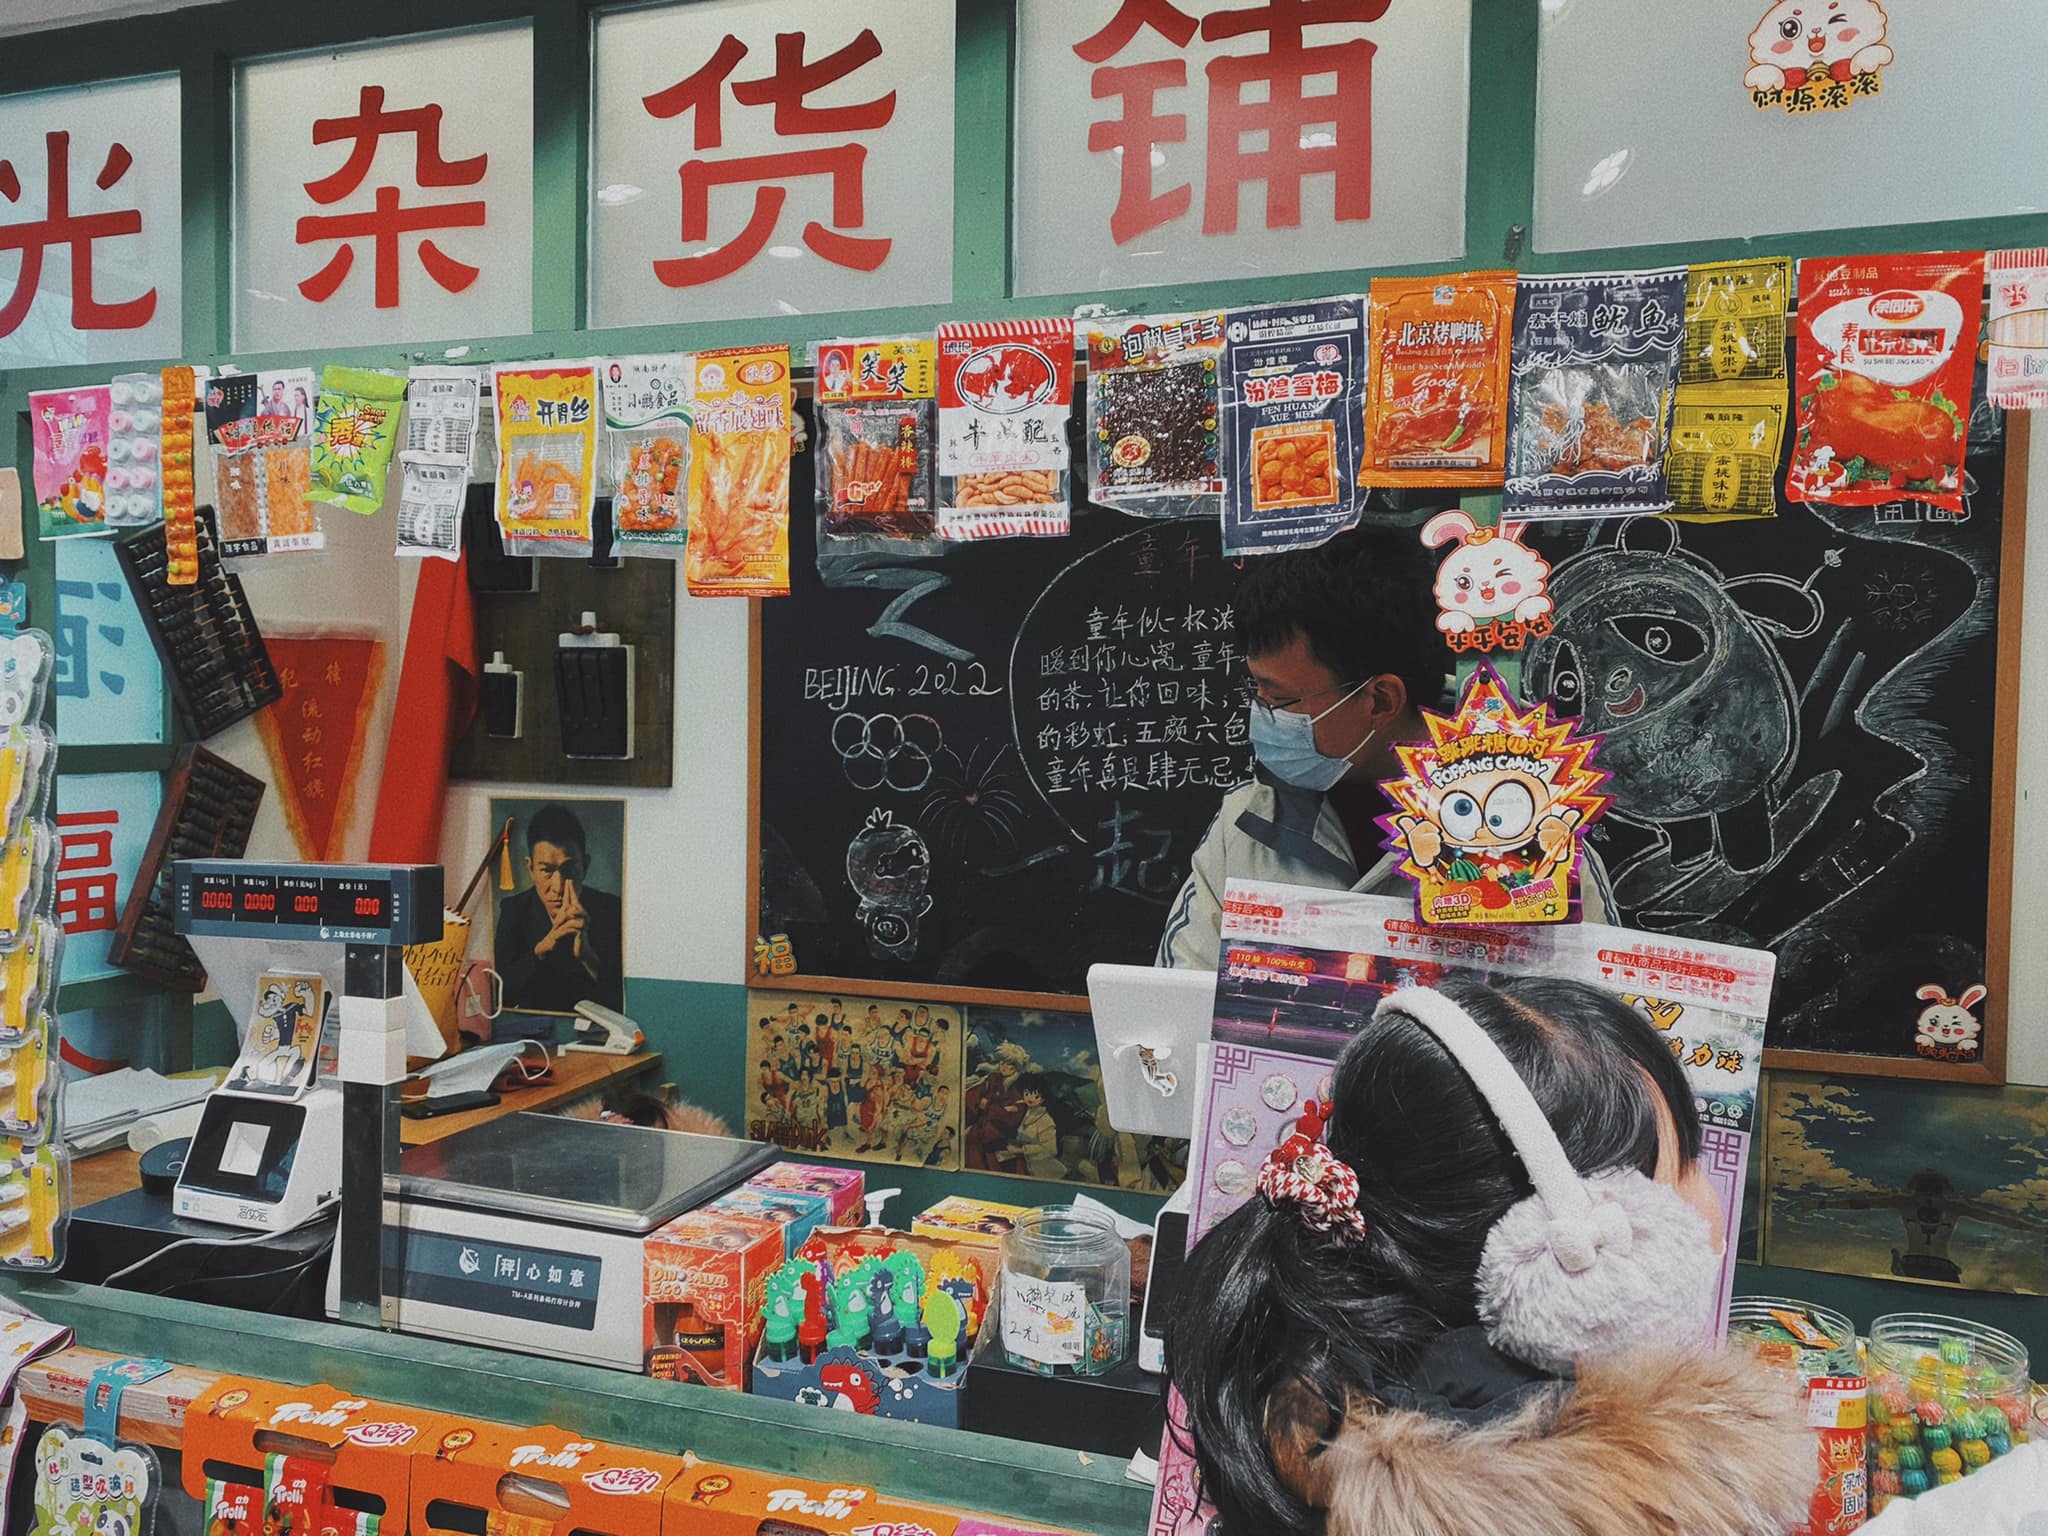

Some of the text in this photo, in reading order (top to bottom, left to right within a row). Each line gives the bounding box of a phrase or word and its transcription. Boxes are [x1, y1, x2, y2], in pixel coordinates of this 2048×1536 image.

[1753, 73, 1879, 113] 财源滚滚
[1398, 320, 1485, 347] 北京烤鸭味
[860, 349, 913, 395] 笑笑
[1245, 373, 1341, 408] 汾煌雪梅
[535, 396, 590, 427] 开胃丝
[1262, 404, 1281, 416] FEN
[1270, 413, 1290, 423] XUE
[804, 661, 1004, 712] BEIJING 2022
[1431, 754, 1550, 789] POPPING CANDY
[753, 933, 797, 976] 福
[650, 1281, 684, 1297] EGG
[269, 1402, 350, 1427] Trolli
[509, 1444, 581, 1469] Trolli
[274, 1485, 303, 1504] Trolli
[767, 1489, 853, 1520] Trolli
[217, 1500, 247, 1520] Trolli
